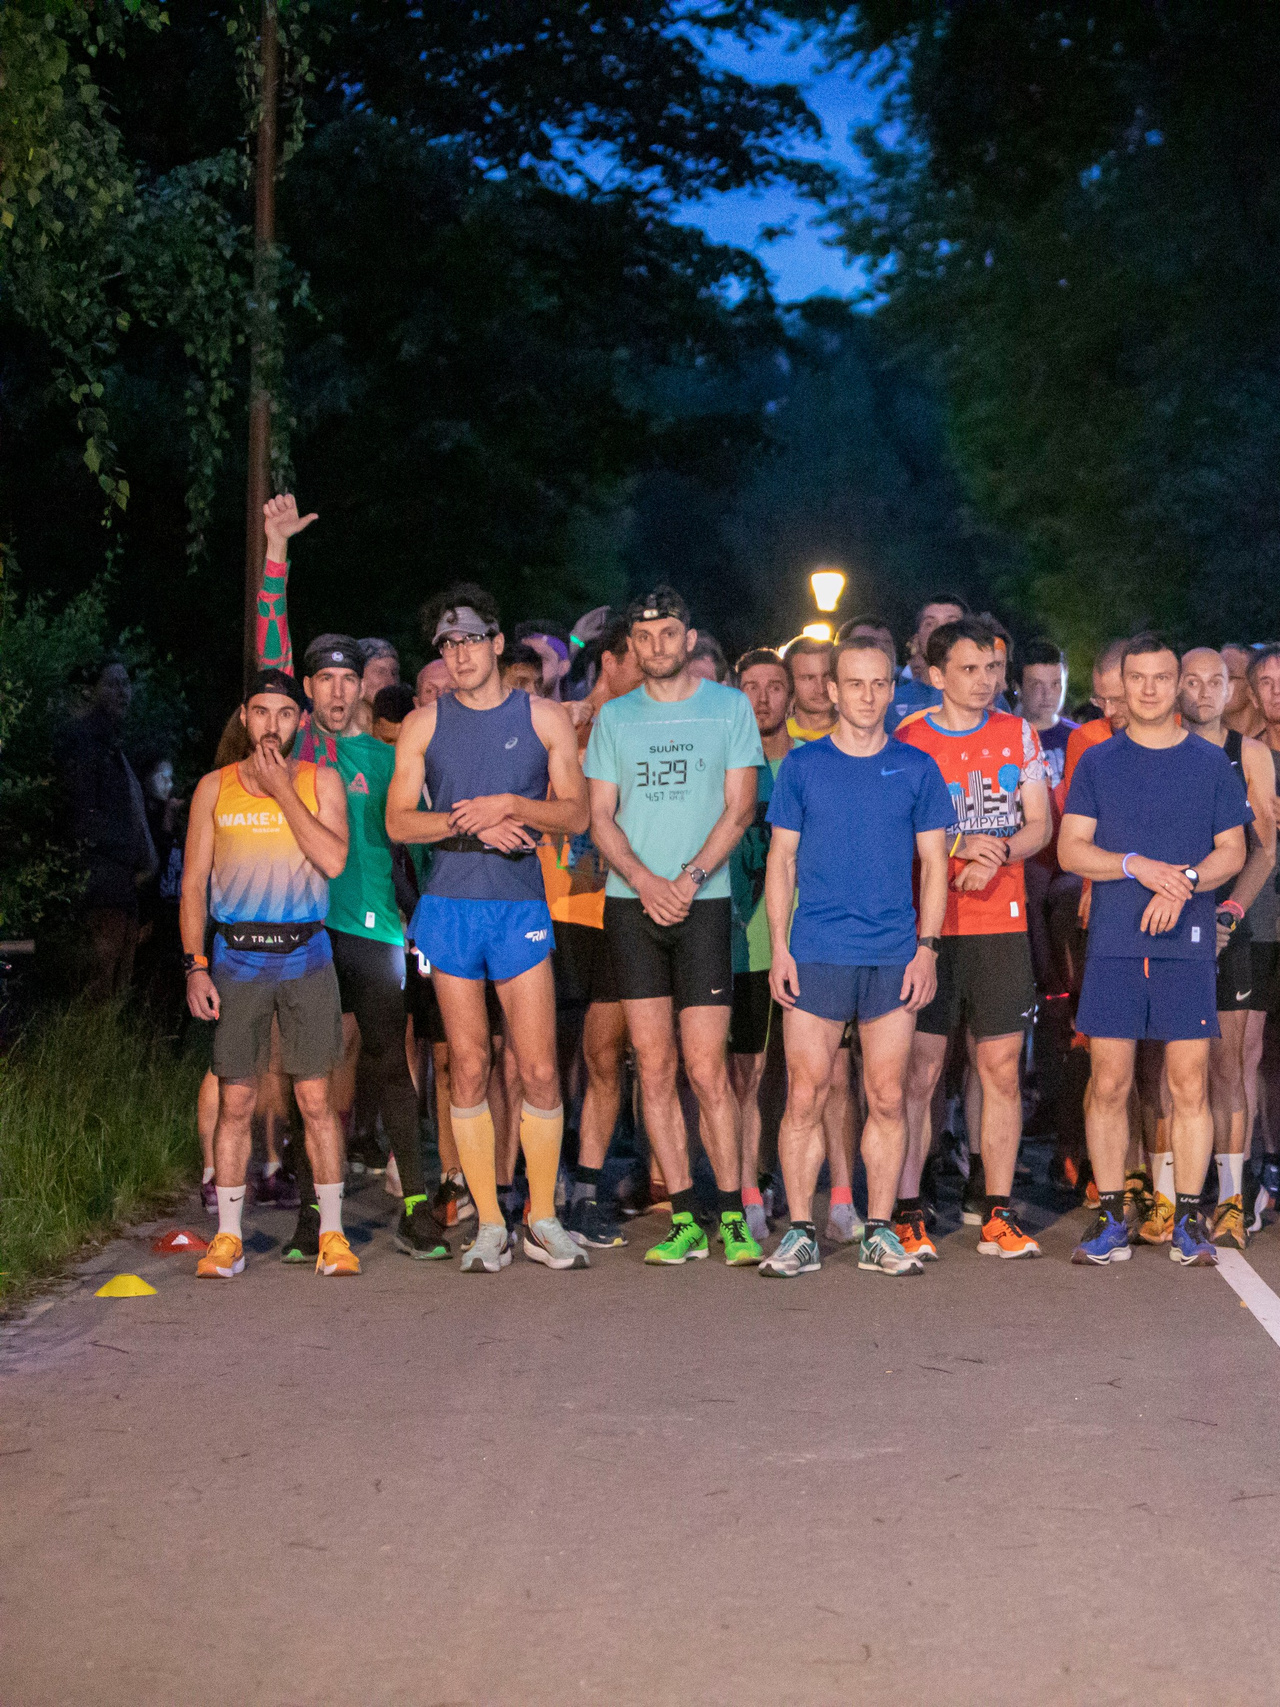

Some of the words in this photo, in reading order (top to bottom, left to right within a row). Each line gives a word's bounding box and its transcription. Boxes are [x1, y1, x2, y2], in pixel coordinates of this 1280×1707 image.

[649, 743, 694, 754] SUUNTO
[636, 759, 688, 787] 3:29
[645, 791, 664, 801] 4:57
